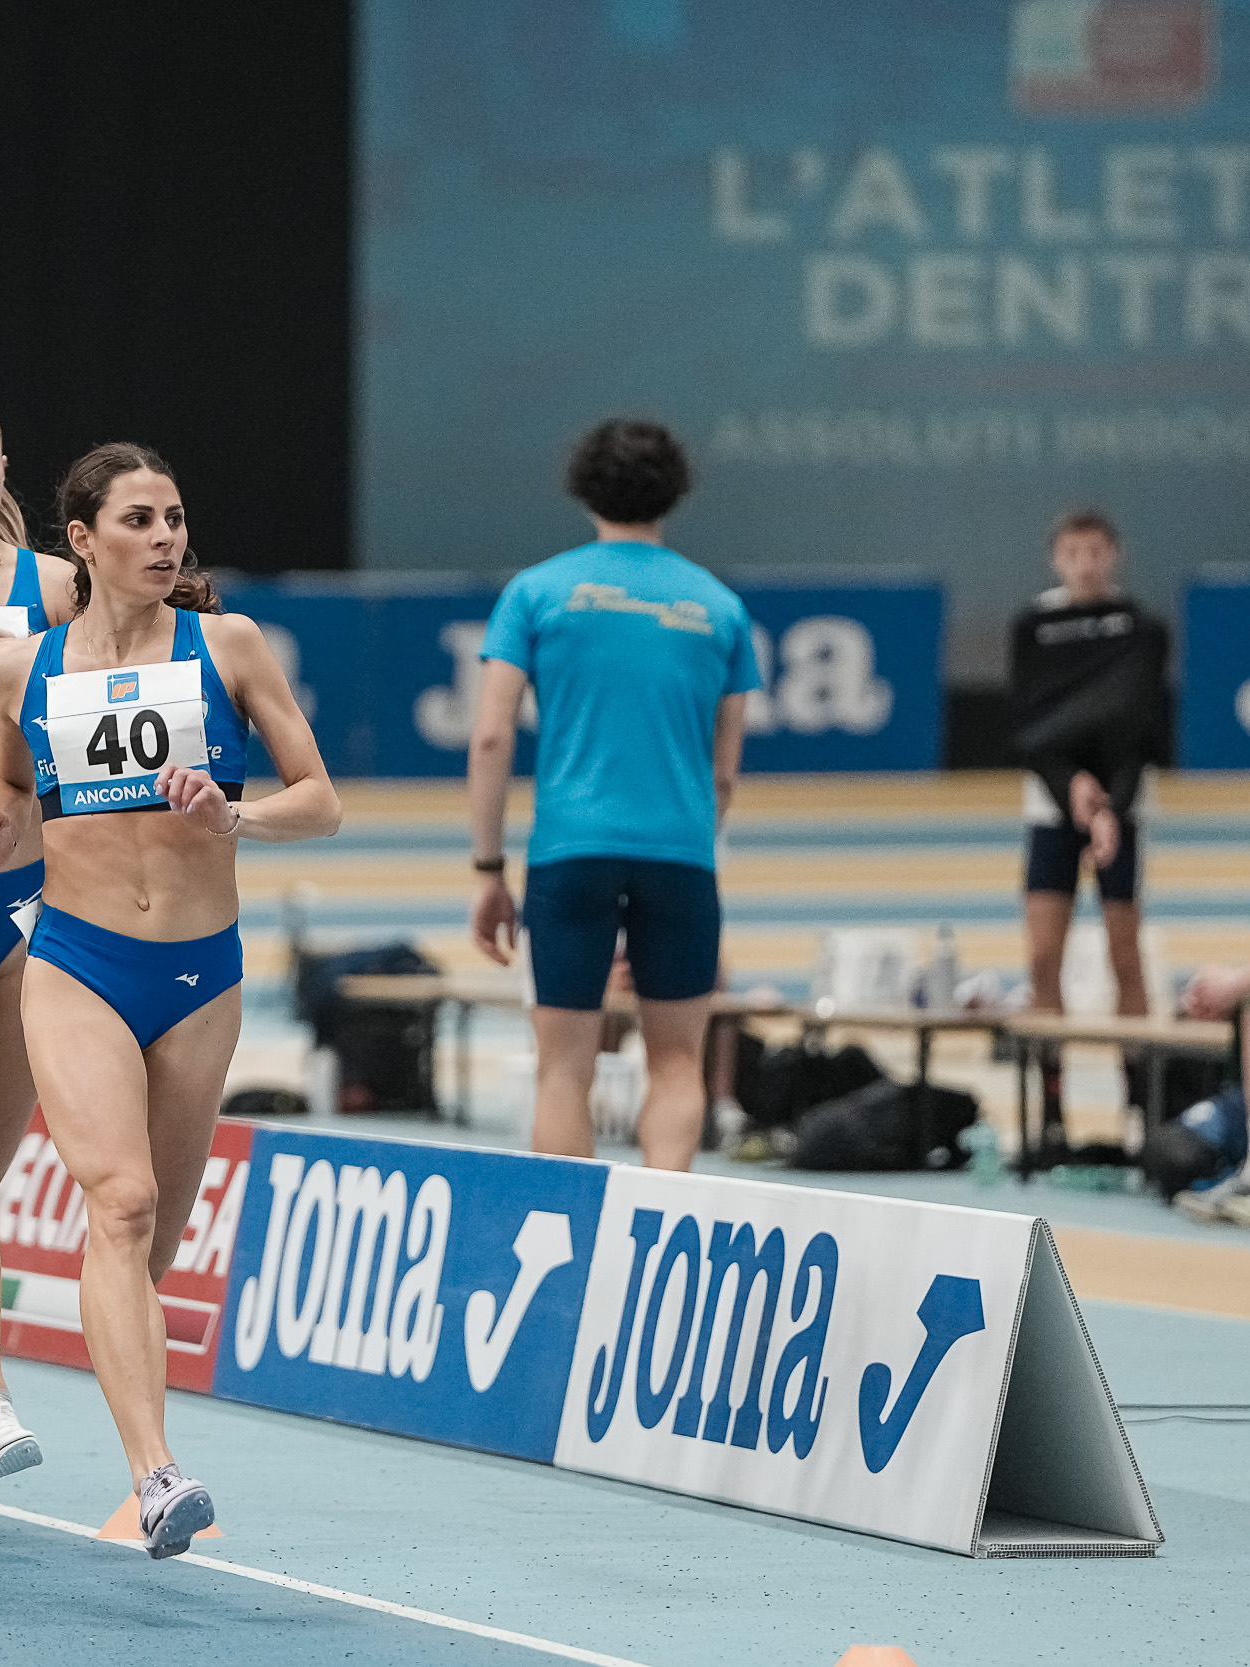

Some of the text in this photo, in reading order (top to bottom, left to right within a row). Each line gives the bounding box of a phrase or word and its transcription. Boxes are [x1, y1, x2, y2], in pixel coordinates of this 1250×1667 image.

[74, 783, 150, 806] ANCONA
[86, 709, 169, 775] 40
[235, 1153, 452, 1382] Joma
[587, 1207, 839, 1460] Joma
